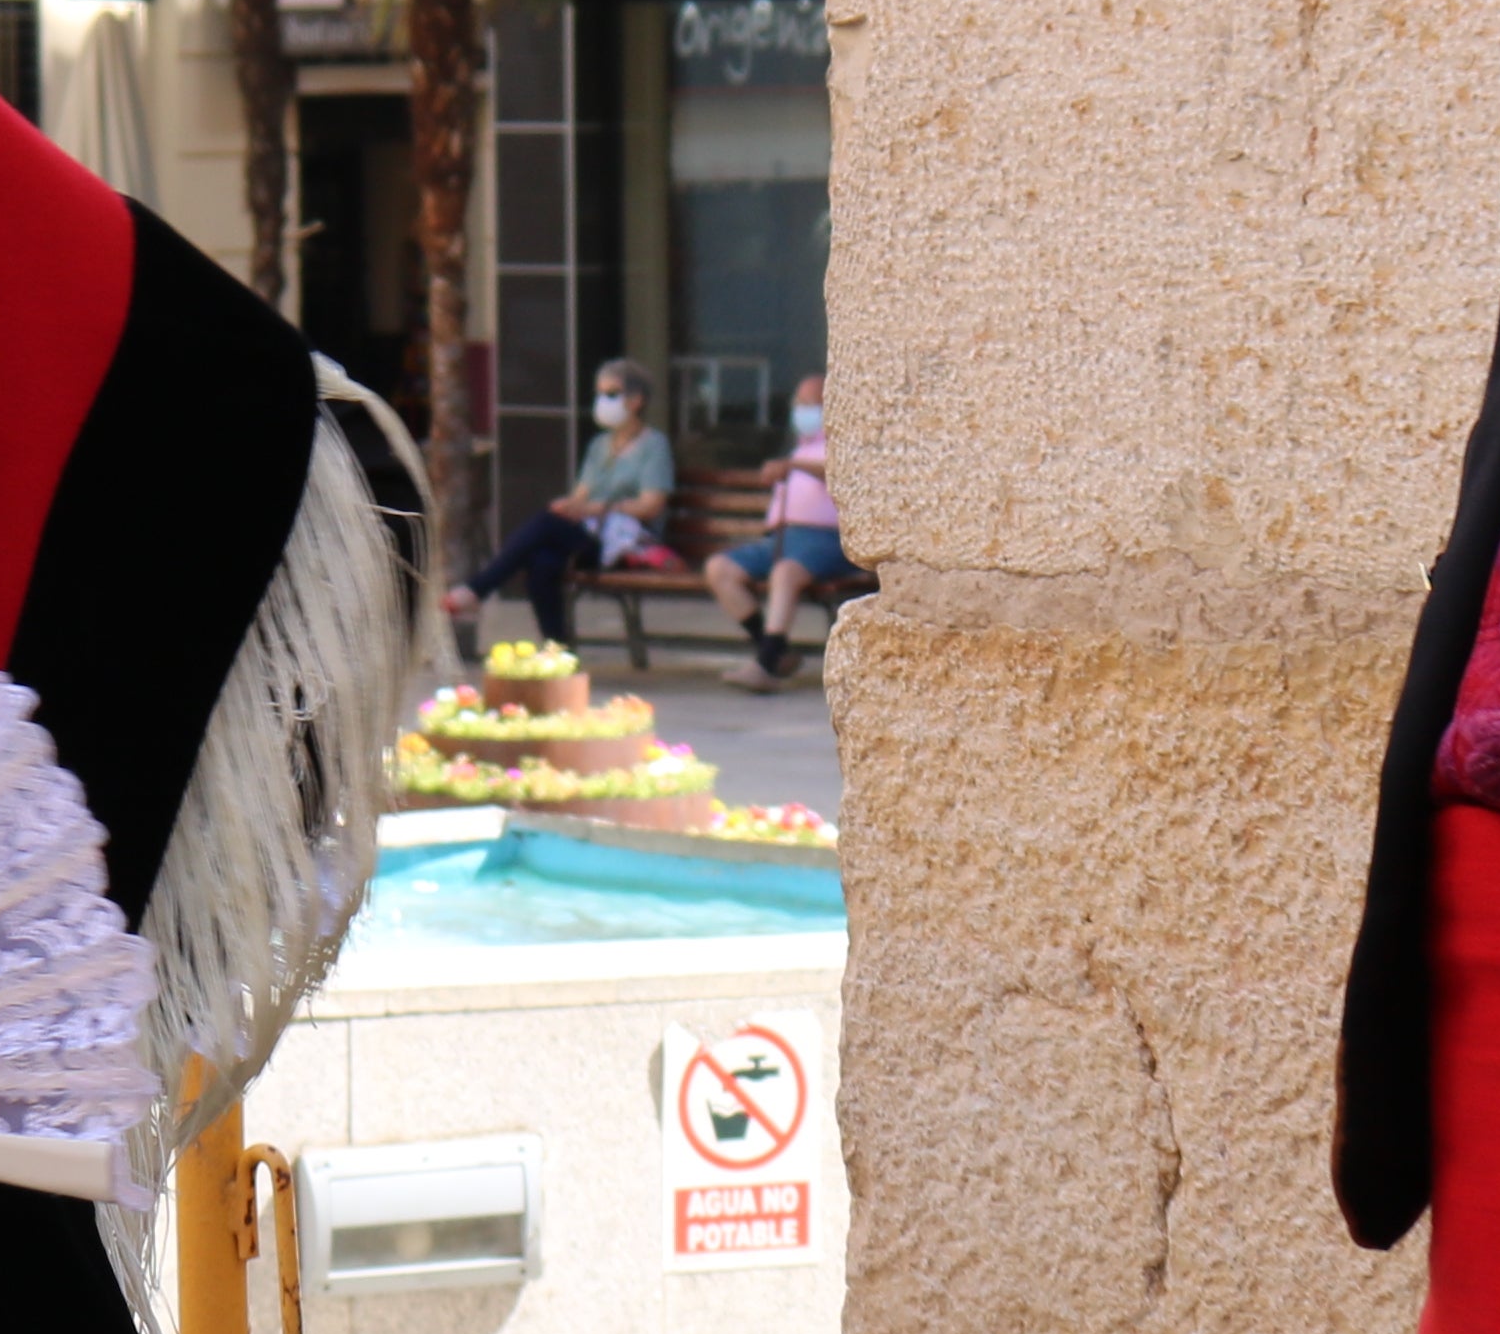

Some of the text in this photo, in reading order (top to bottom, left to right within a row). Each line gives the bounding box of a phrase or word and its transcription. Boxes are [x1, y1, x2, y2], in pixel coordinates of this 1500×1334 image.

[687, 1185, 799, 1217] AGUA NO
[687, 1219, 798, 1252] POTABLE
